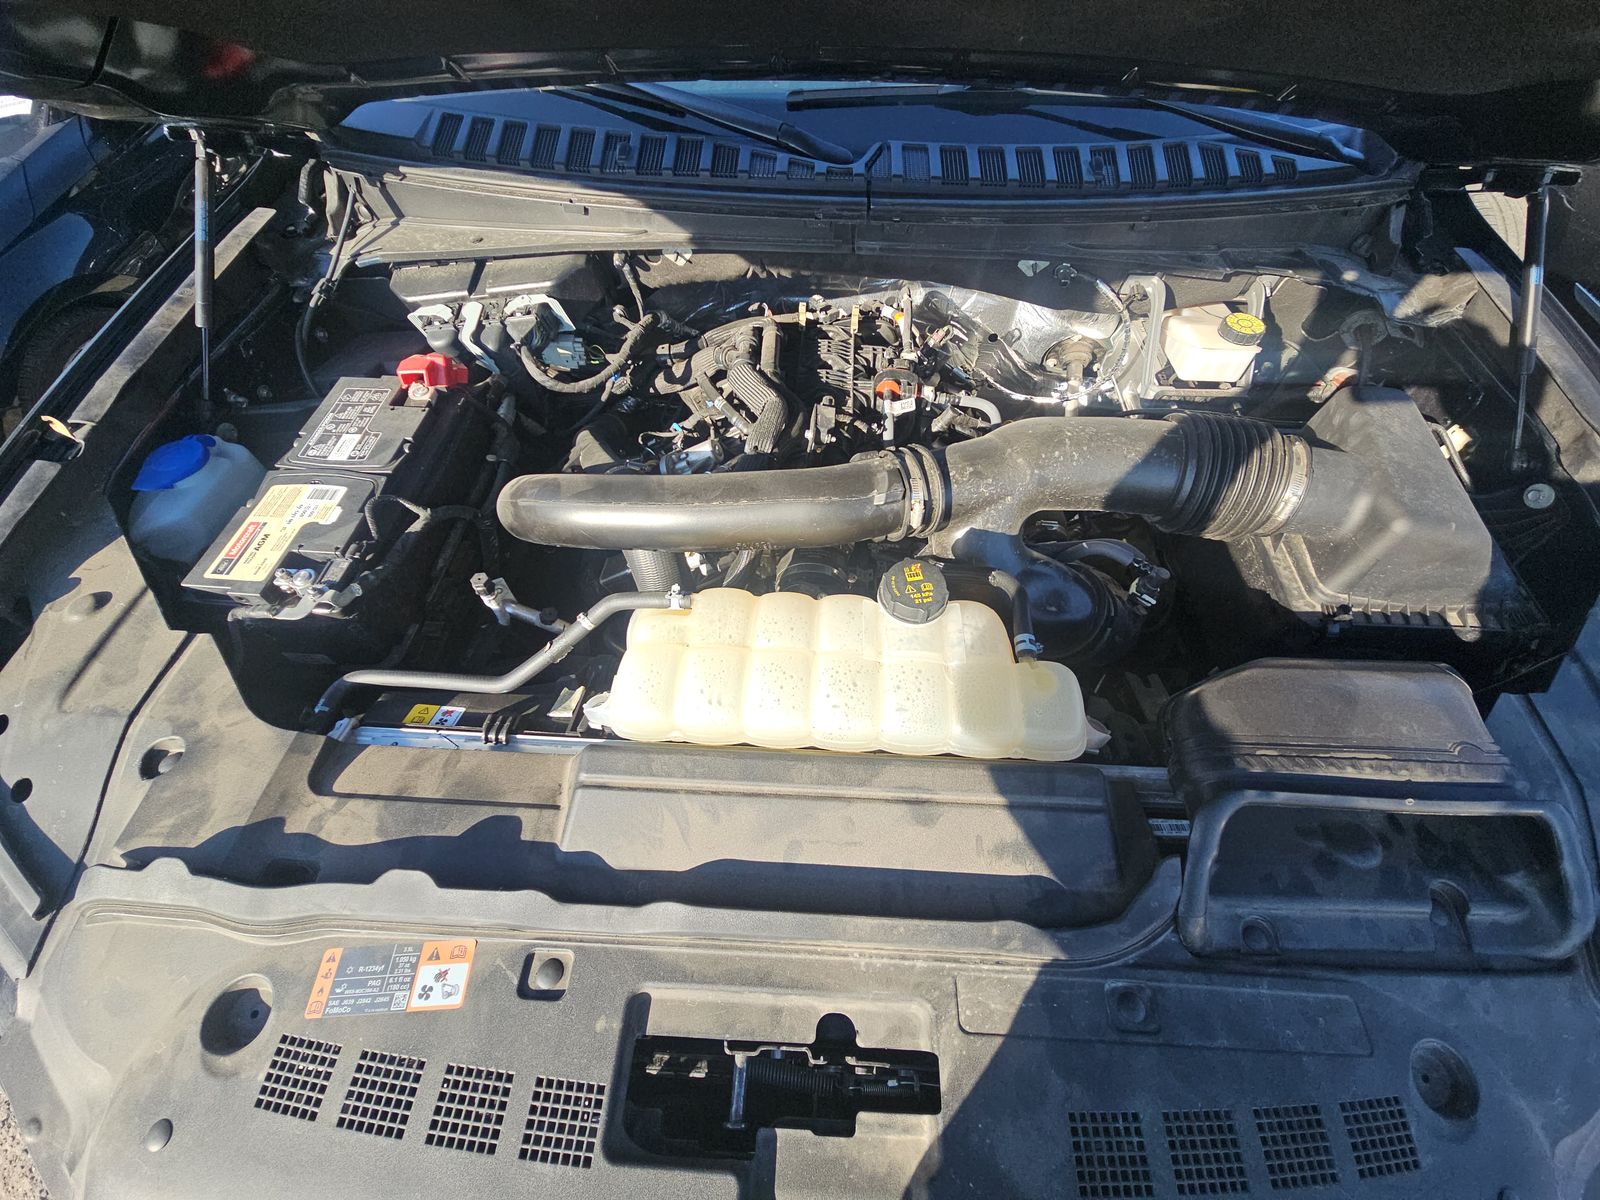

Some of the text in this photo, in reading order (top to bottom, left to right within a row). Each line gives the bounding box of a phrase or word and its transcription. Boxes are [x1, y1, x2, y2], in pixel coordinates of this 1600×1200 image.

[255, 533, 271, 551] AGM
[358, 964, 385, 973] R-1234yf
[367, 979, 381, 987] PAG
[328, 999, 339, 1007] SAE
[324, 1006, 352, 1014] FoMoCo
